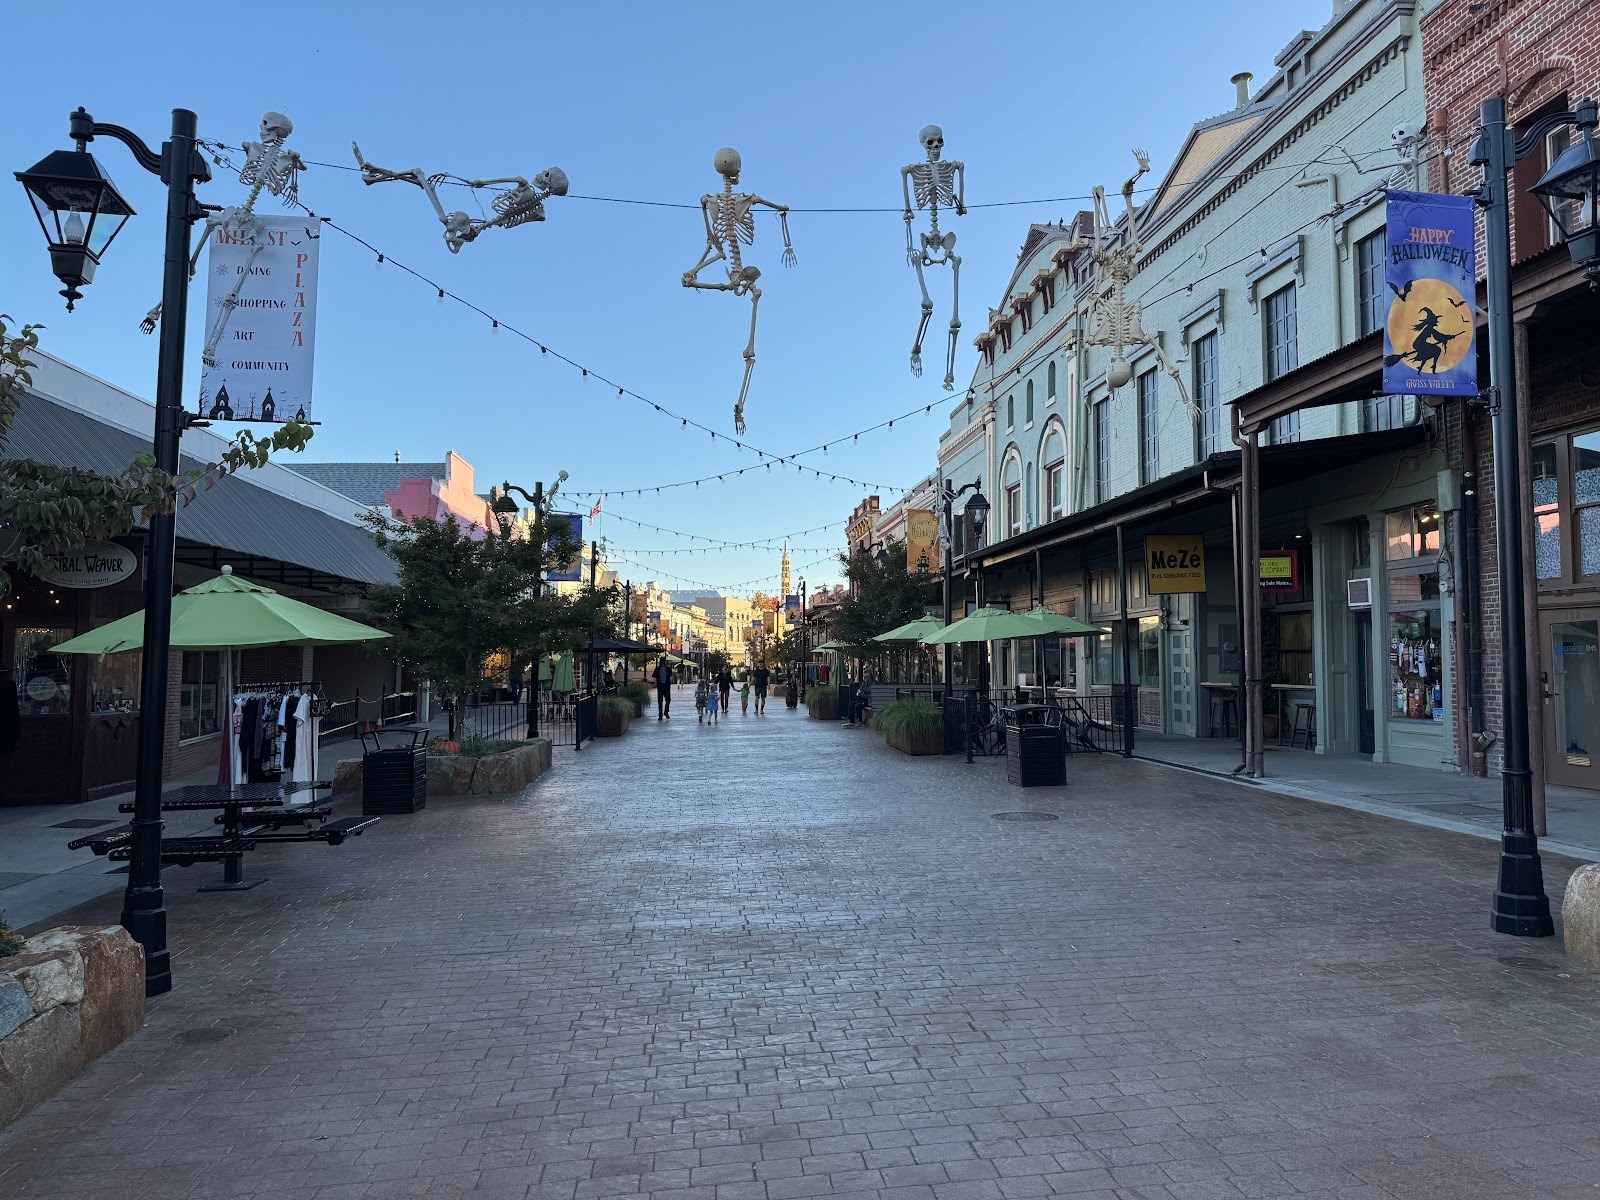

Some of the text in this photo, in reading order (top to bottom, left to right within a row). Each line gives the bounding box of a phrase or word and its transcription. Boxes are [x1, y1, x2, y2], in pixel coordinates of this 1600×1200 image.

[215, 229, 288, 247] MIL ST
[1403, 227, 1455, 245] HAPPY
[1391, 243, 1472, 273] HALLOWEEN
[236, 265, 271, 276] DNING
[291, 253, 308, 347] PLAZA
[233, 330, 255, 341] ART
[231, 360, 291, 371] COMMUNITY
[1405, 378, 1455, 389] GRASS VALLEY
[1151, 545, 1201, 570] MeZé
